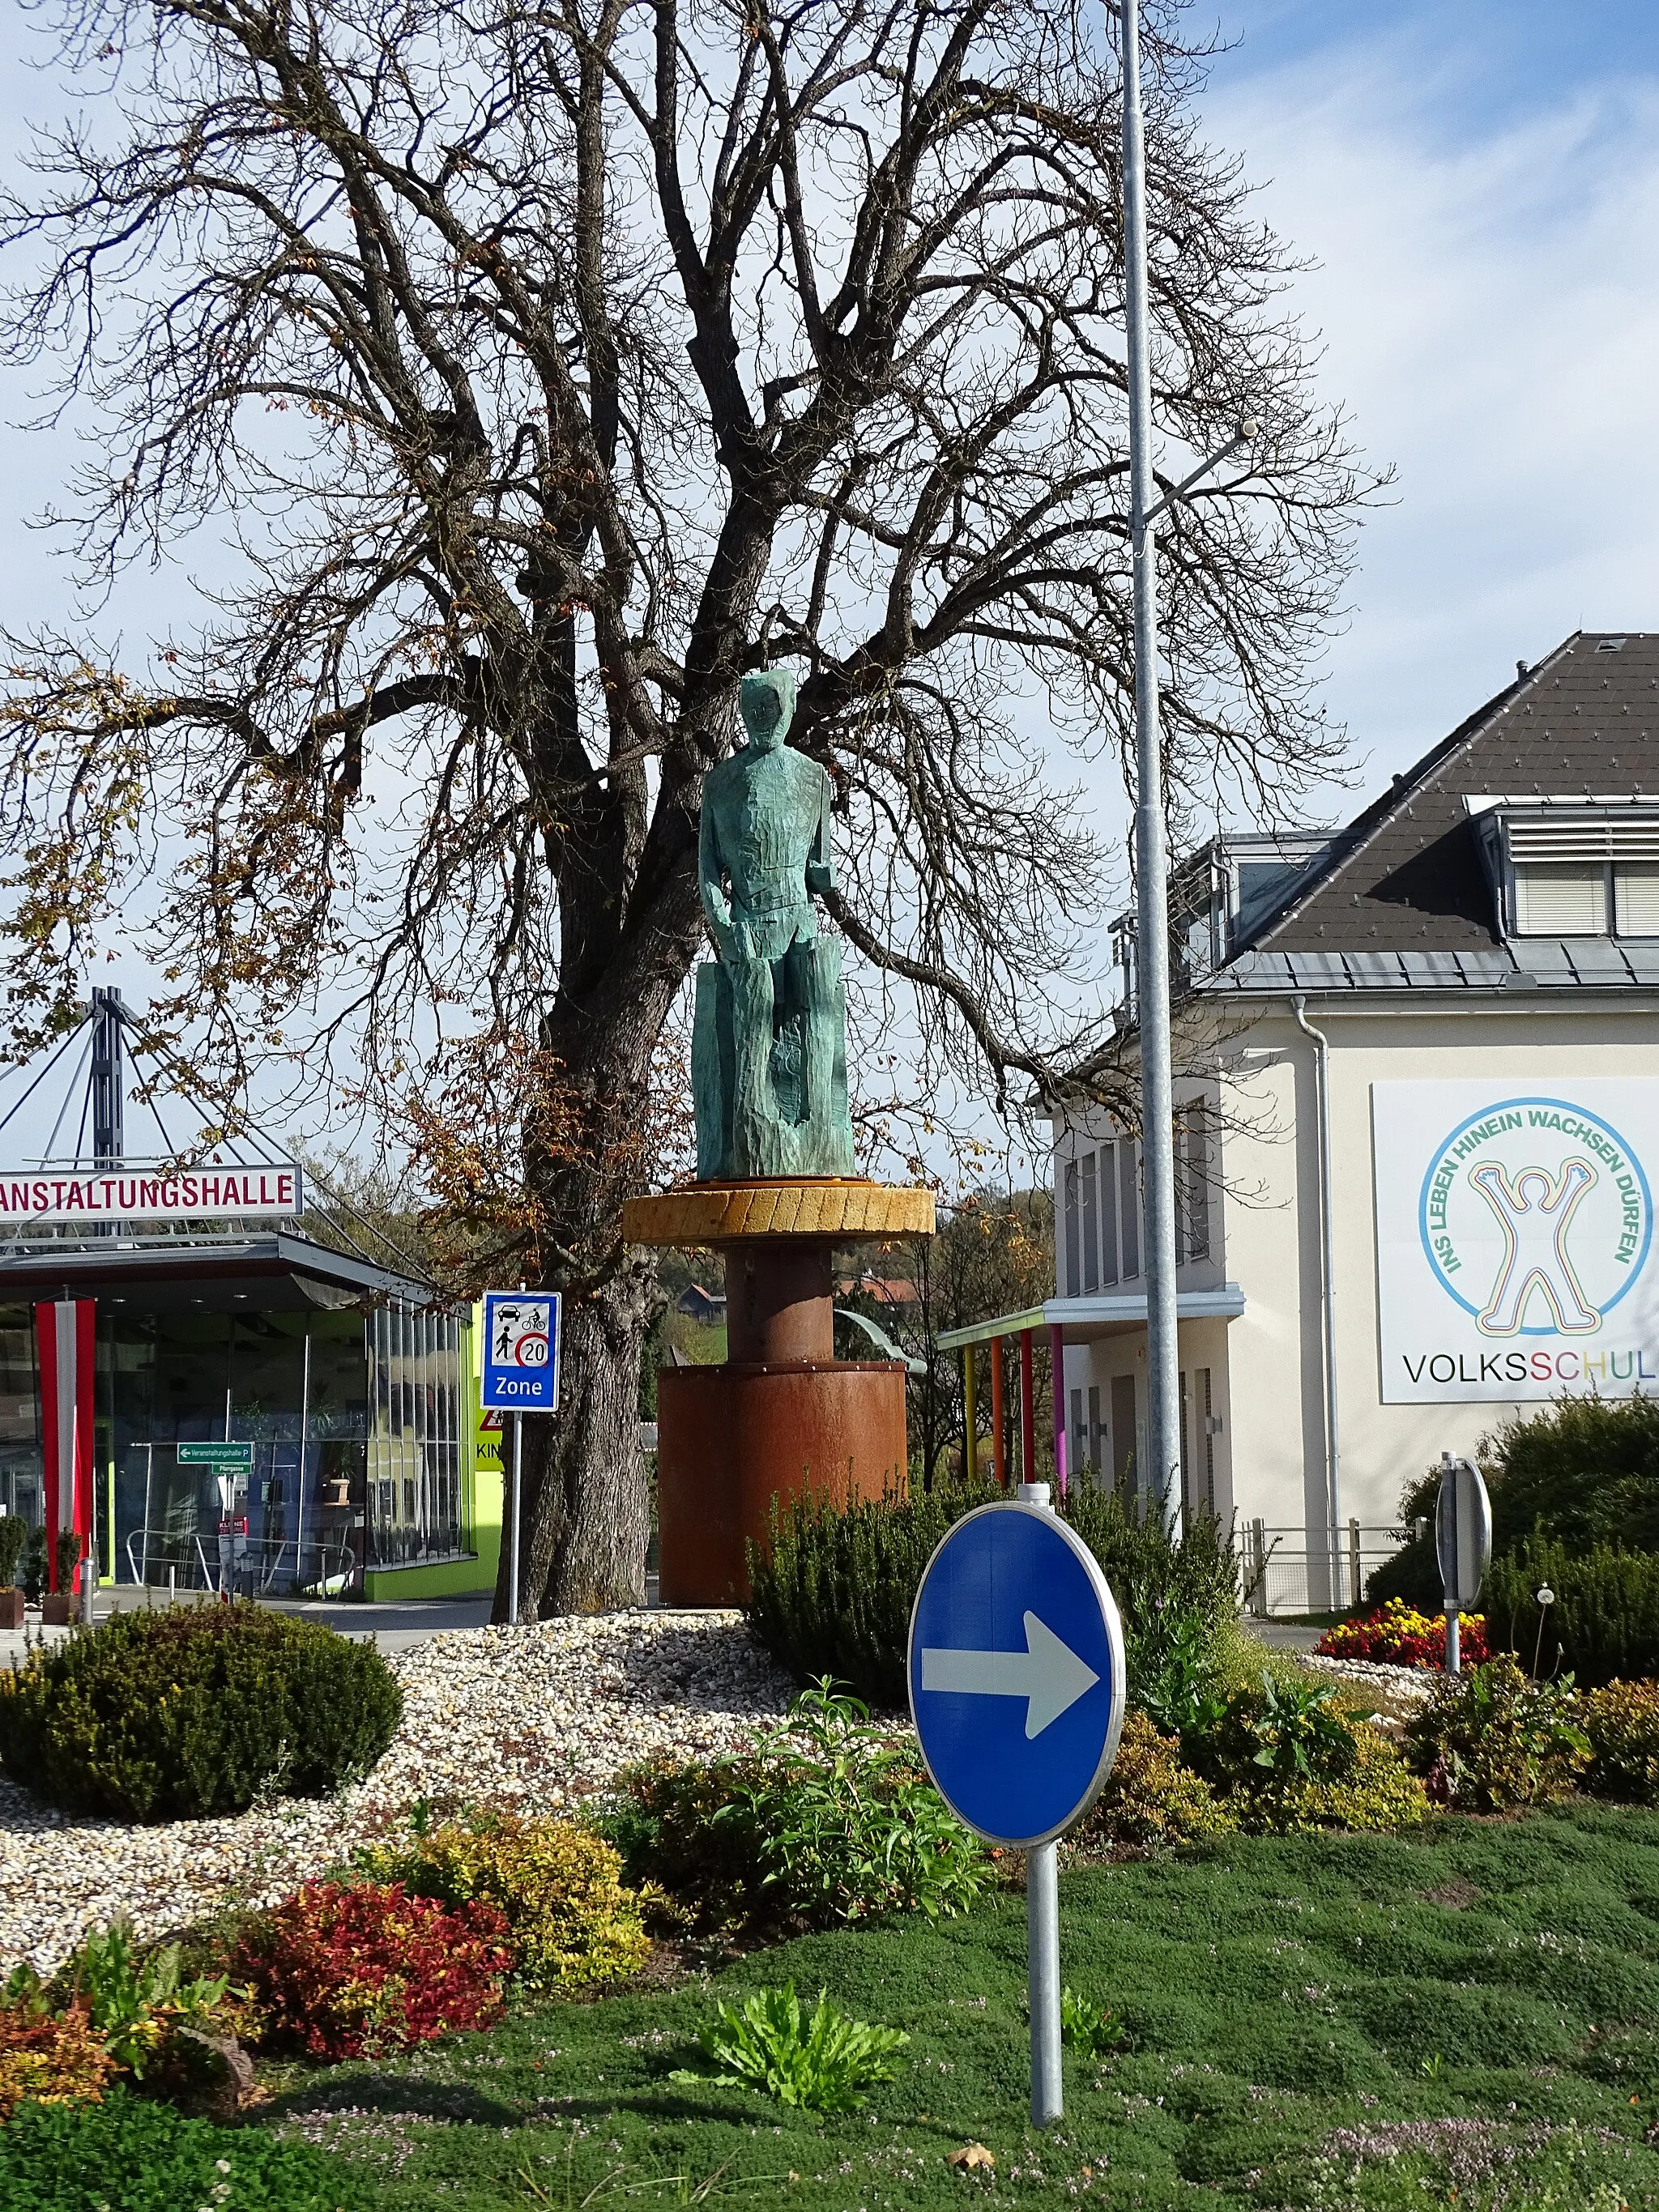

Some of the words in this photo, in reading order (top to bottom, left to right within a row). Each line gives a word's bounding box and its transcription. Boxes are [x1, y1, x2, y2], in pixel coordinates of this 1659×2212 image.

[1452, 1111, 1523, 1160] HINEIN
[1528, 1110, 1625, 1173] WACHSEN
[1430, 1158, 1460, 1230] LEBEN
[1614, 1174, 1642, 1264] DÜRFEN
[1434, 1235, 1462, 1274] INS
[525, 1343, 544, 1361] 20
[1402, 1350, 1656, 1383] VOLKSSCHUL
[496, 1377, 543, 1396] Zone
[191, 1449, 241, 1458] Veranstaltungshalle
[243, 1449, 249, 1457] P
